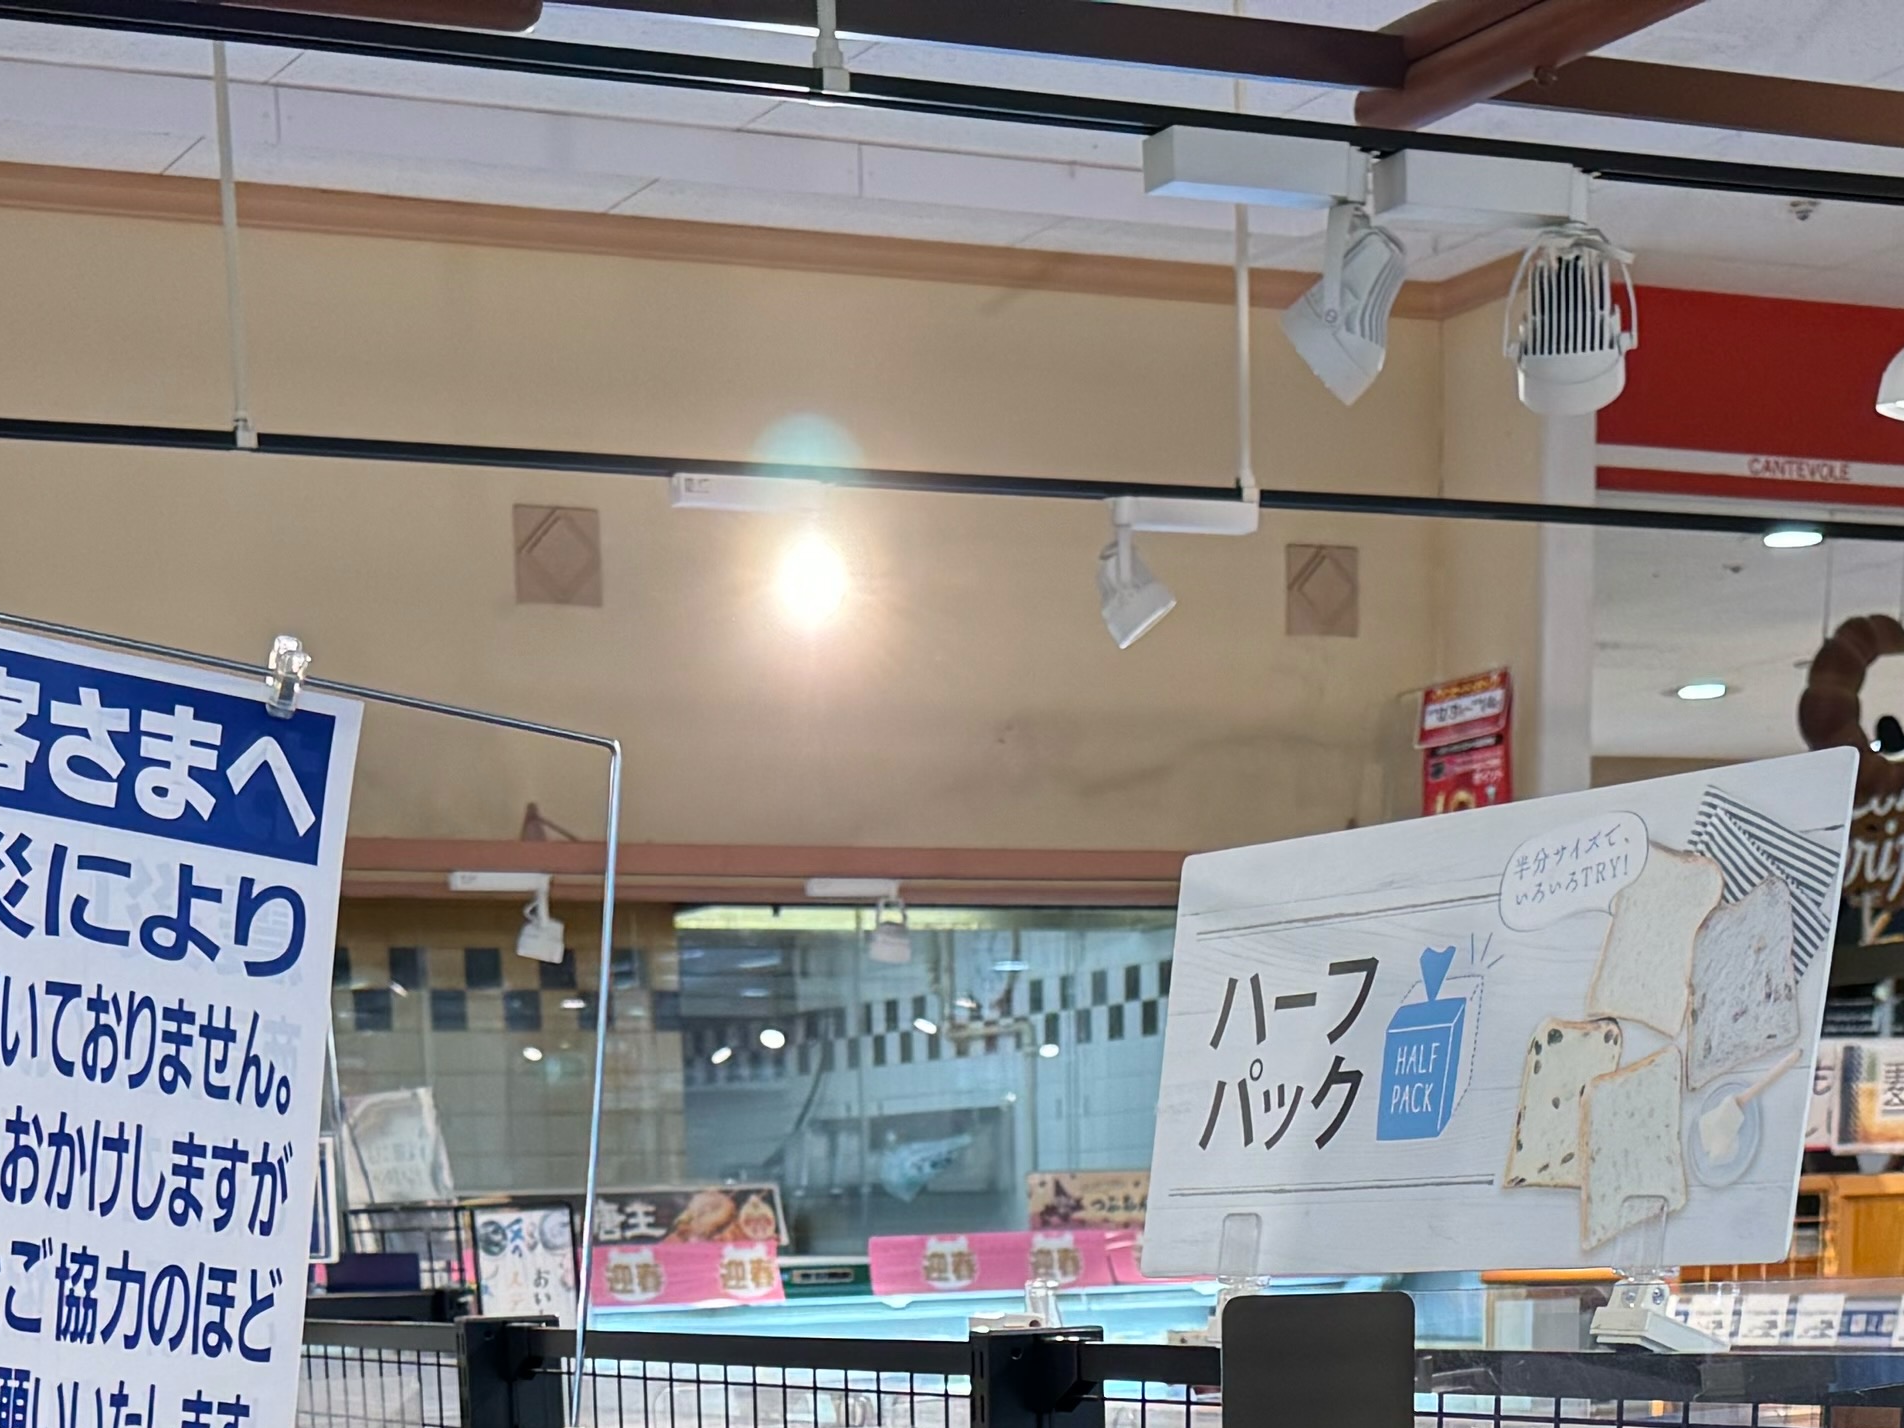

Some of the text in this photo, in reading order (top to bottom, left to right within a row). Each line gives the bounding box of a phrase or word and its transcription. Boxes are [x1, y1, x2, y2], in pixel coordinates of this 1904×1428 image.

[1747, 457, 1850, 482] CANTEVOLE
[1512, 825, 1634, 878] 半分サイズで、
[1514, 856, 1630, 907] いろいろTRY!
[1211, 957, 1379, 1050] ハーフ
[1395, 1042, 1437, 1075] HALF
[1199, 1055, 1365, 1151] パック
[1390, 1080, 1434, 1114] PACK
